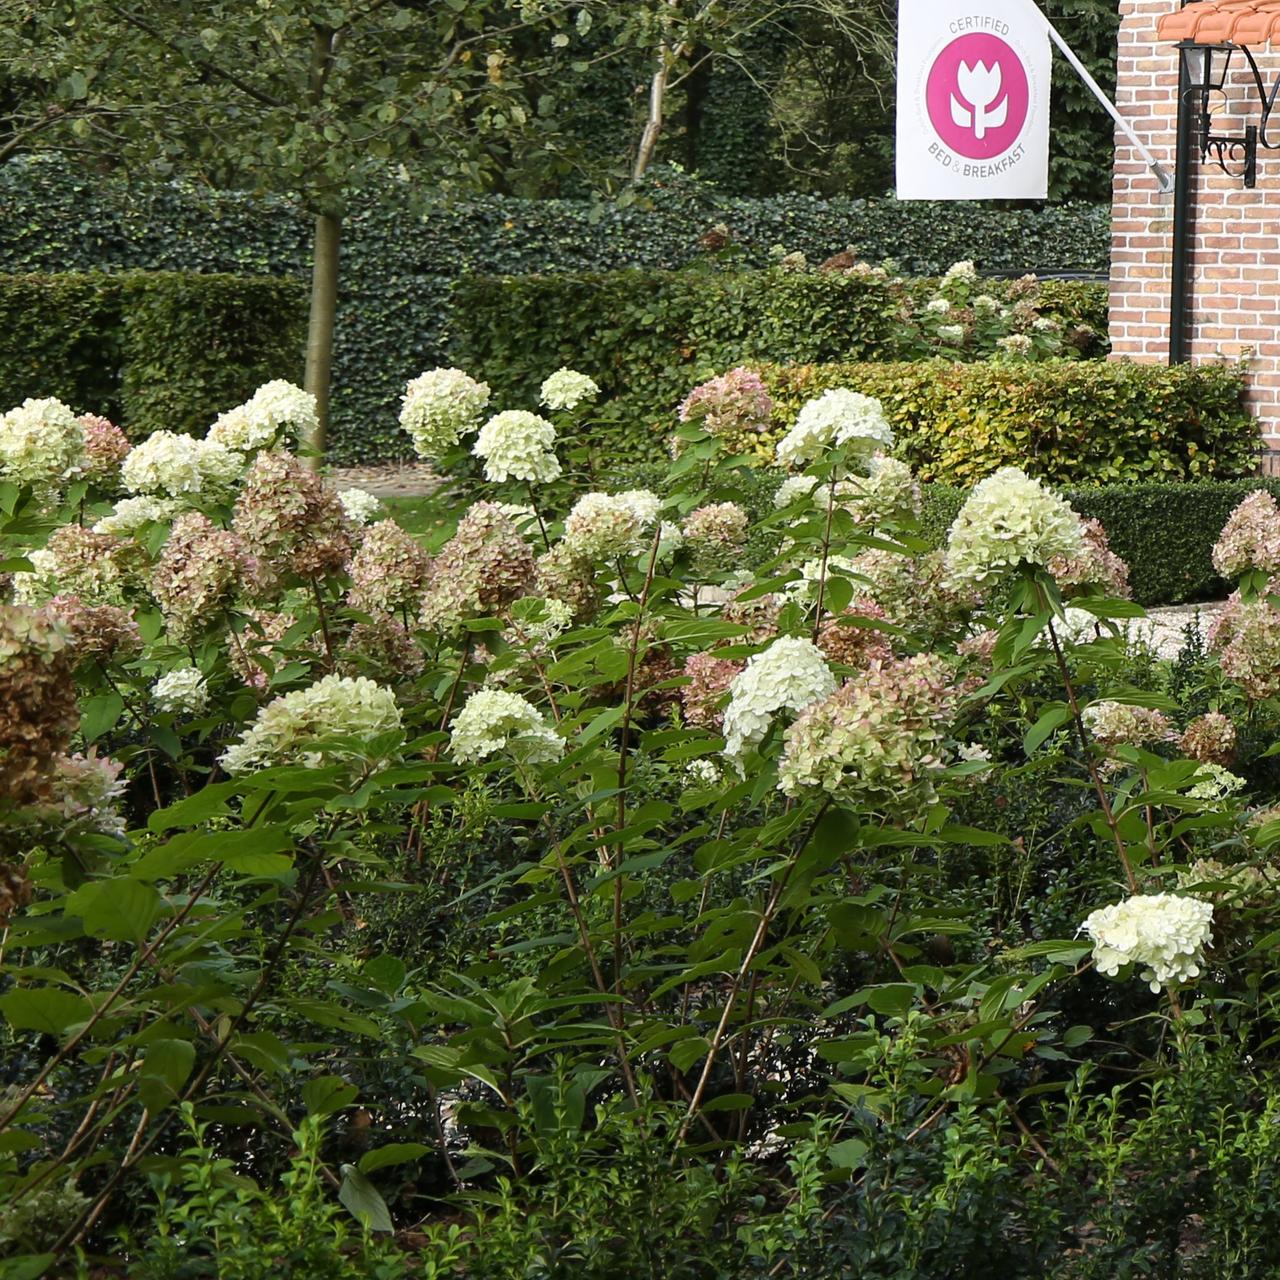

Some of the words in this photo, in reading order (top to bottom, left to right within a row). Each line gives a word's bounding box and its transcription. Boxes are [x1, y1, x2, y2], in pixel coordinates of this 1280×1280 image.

[949, 16, 1010, 36] CERTIFIED
[928, 142, 952, 167] BED
[952, 160, 960, 173] &
[963, 142, 1026, 178] BREAKFAST
